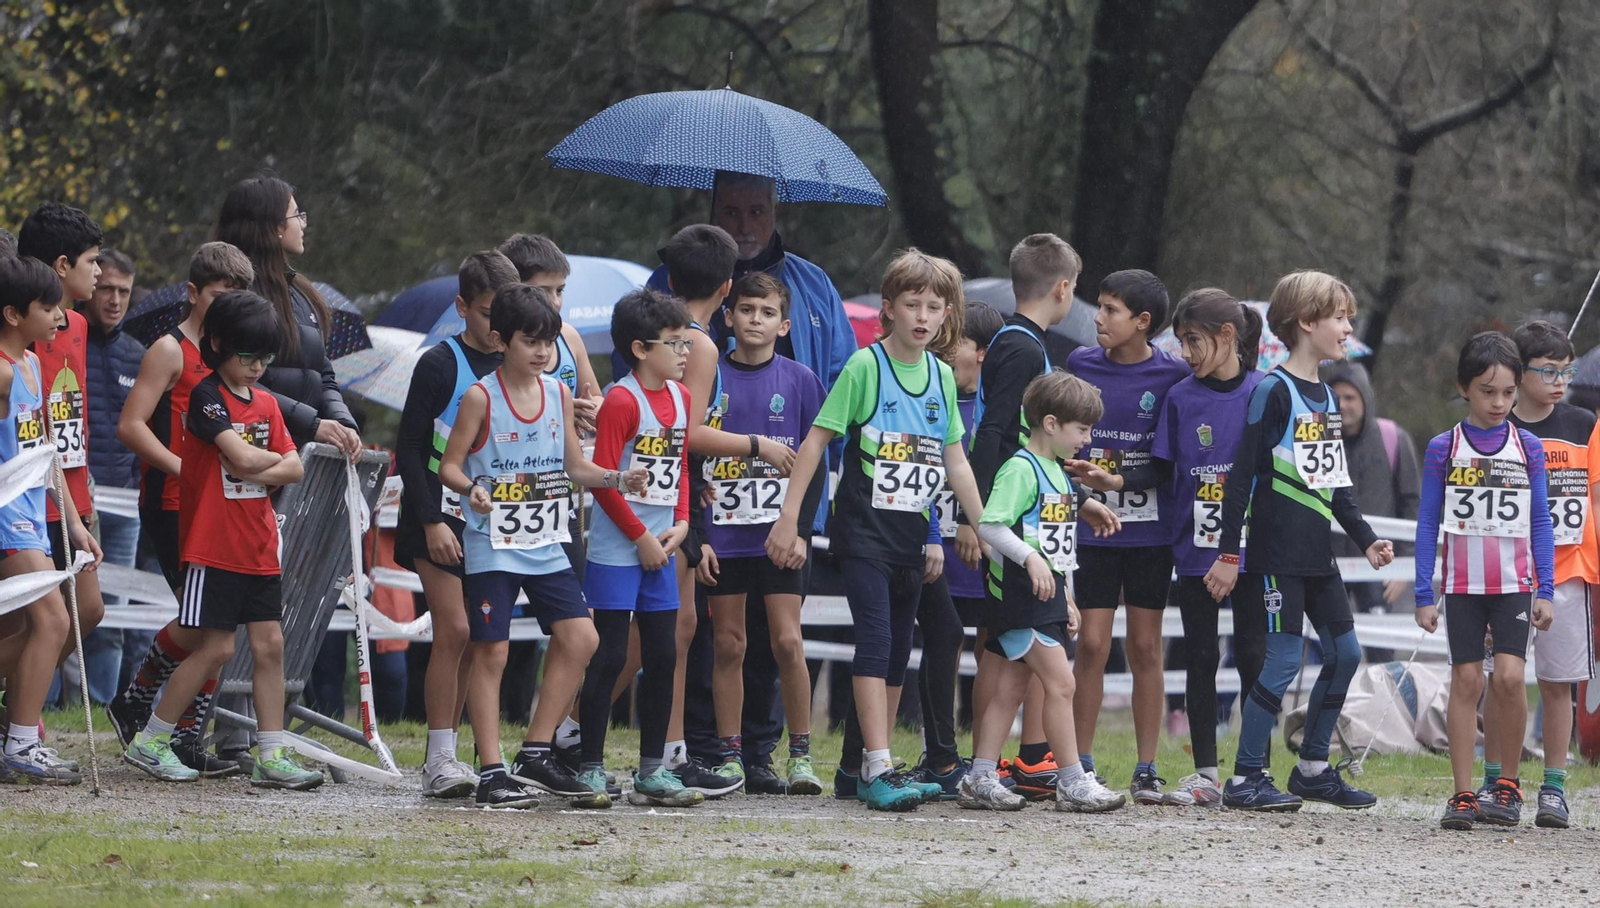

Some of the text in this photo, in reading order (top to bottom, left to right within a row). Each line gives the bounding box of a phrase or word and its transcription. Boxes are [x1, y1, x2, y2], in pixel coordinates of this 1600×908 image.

[1092, 428, 1118, 440] CHANS
[1301, 441, 1343, 474] 351
[490, 458, 520, 471] Celta
[877, 462, 940, 498] 349
[1501, 477, 1530, 486] ALONSO
[1552, 471, 1588, 479] MEMORIAL
[535, 479, 570, 490] BELARMINO
[544, 487, 569, 497] ALONSO
[719, 480, 781, 511] 312
[1452, 488, 1520, 522] 315
[497, 501, 561, 535] 331
